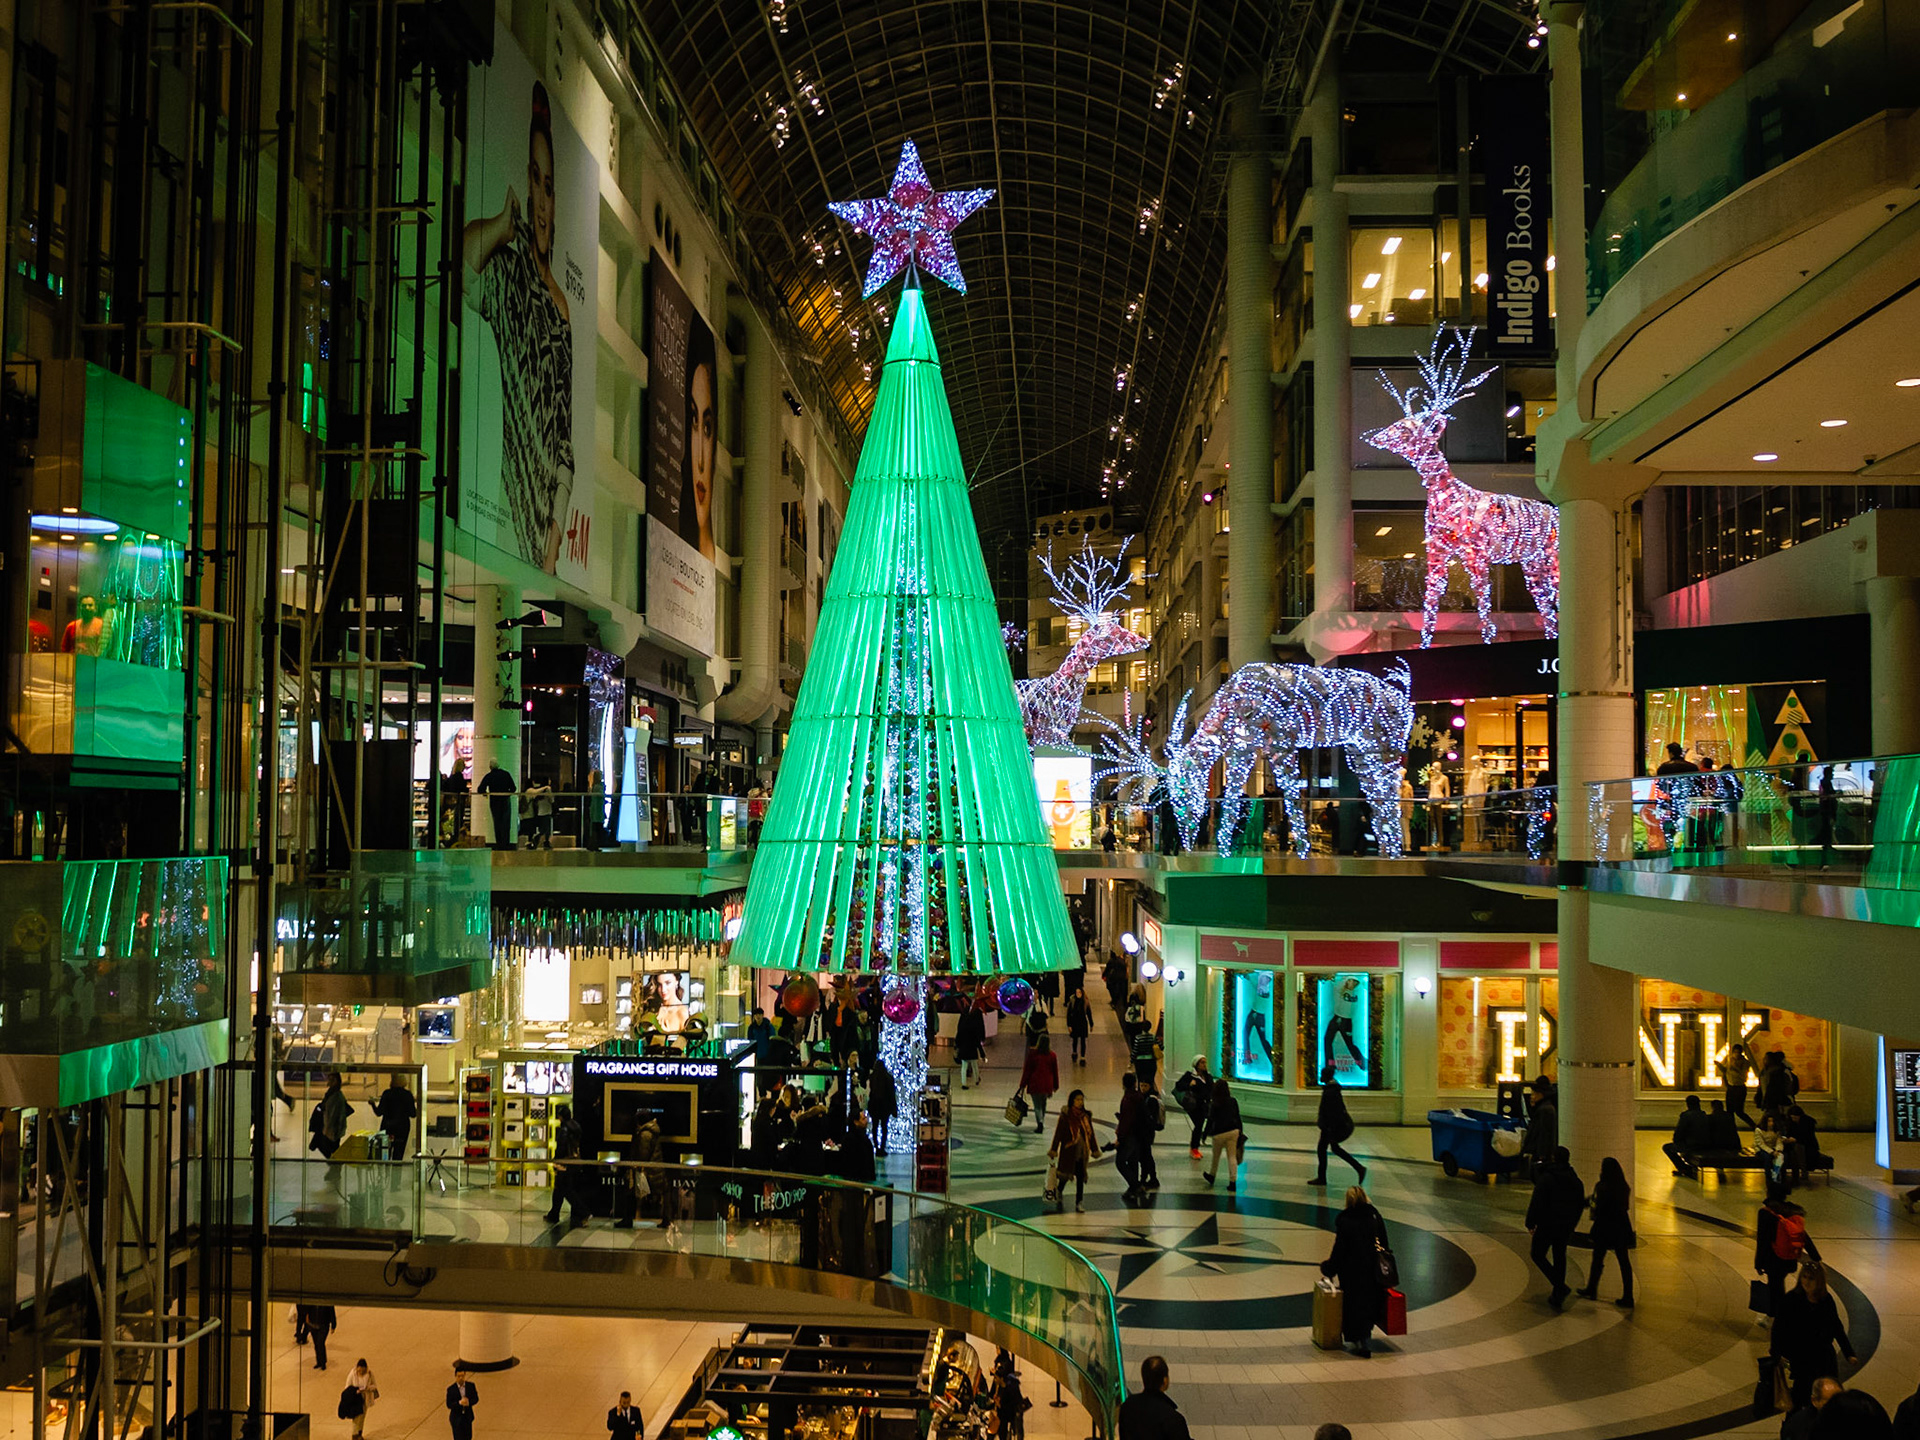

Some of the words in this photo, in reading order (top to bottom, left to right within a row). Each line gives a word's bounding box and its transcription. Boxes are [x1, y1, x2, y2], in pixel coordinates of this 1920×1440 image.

[1502, 164, 1532, 251] Books
[565, 269, 586, 306] $19.99
[1497, 259, 1540, 344] Indigo
[654, 340, 686, 398] INSPIRE
[566, 507, 591, 571] H&M
[586, 1061, 655, 1075] FRAGRANCE
[656, 1063, 680, 1076] GIFT
[680, 1063, 718, 1077] HOUSE
[673, 1178, 698, 1188] BAY
